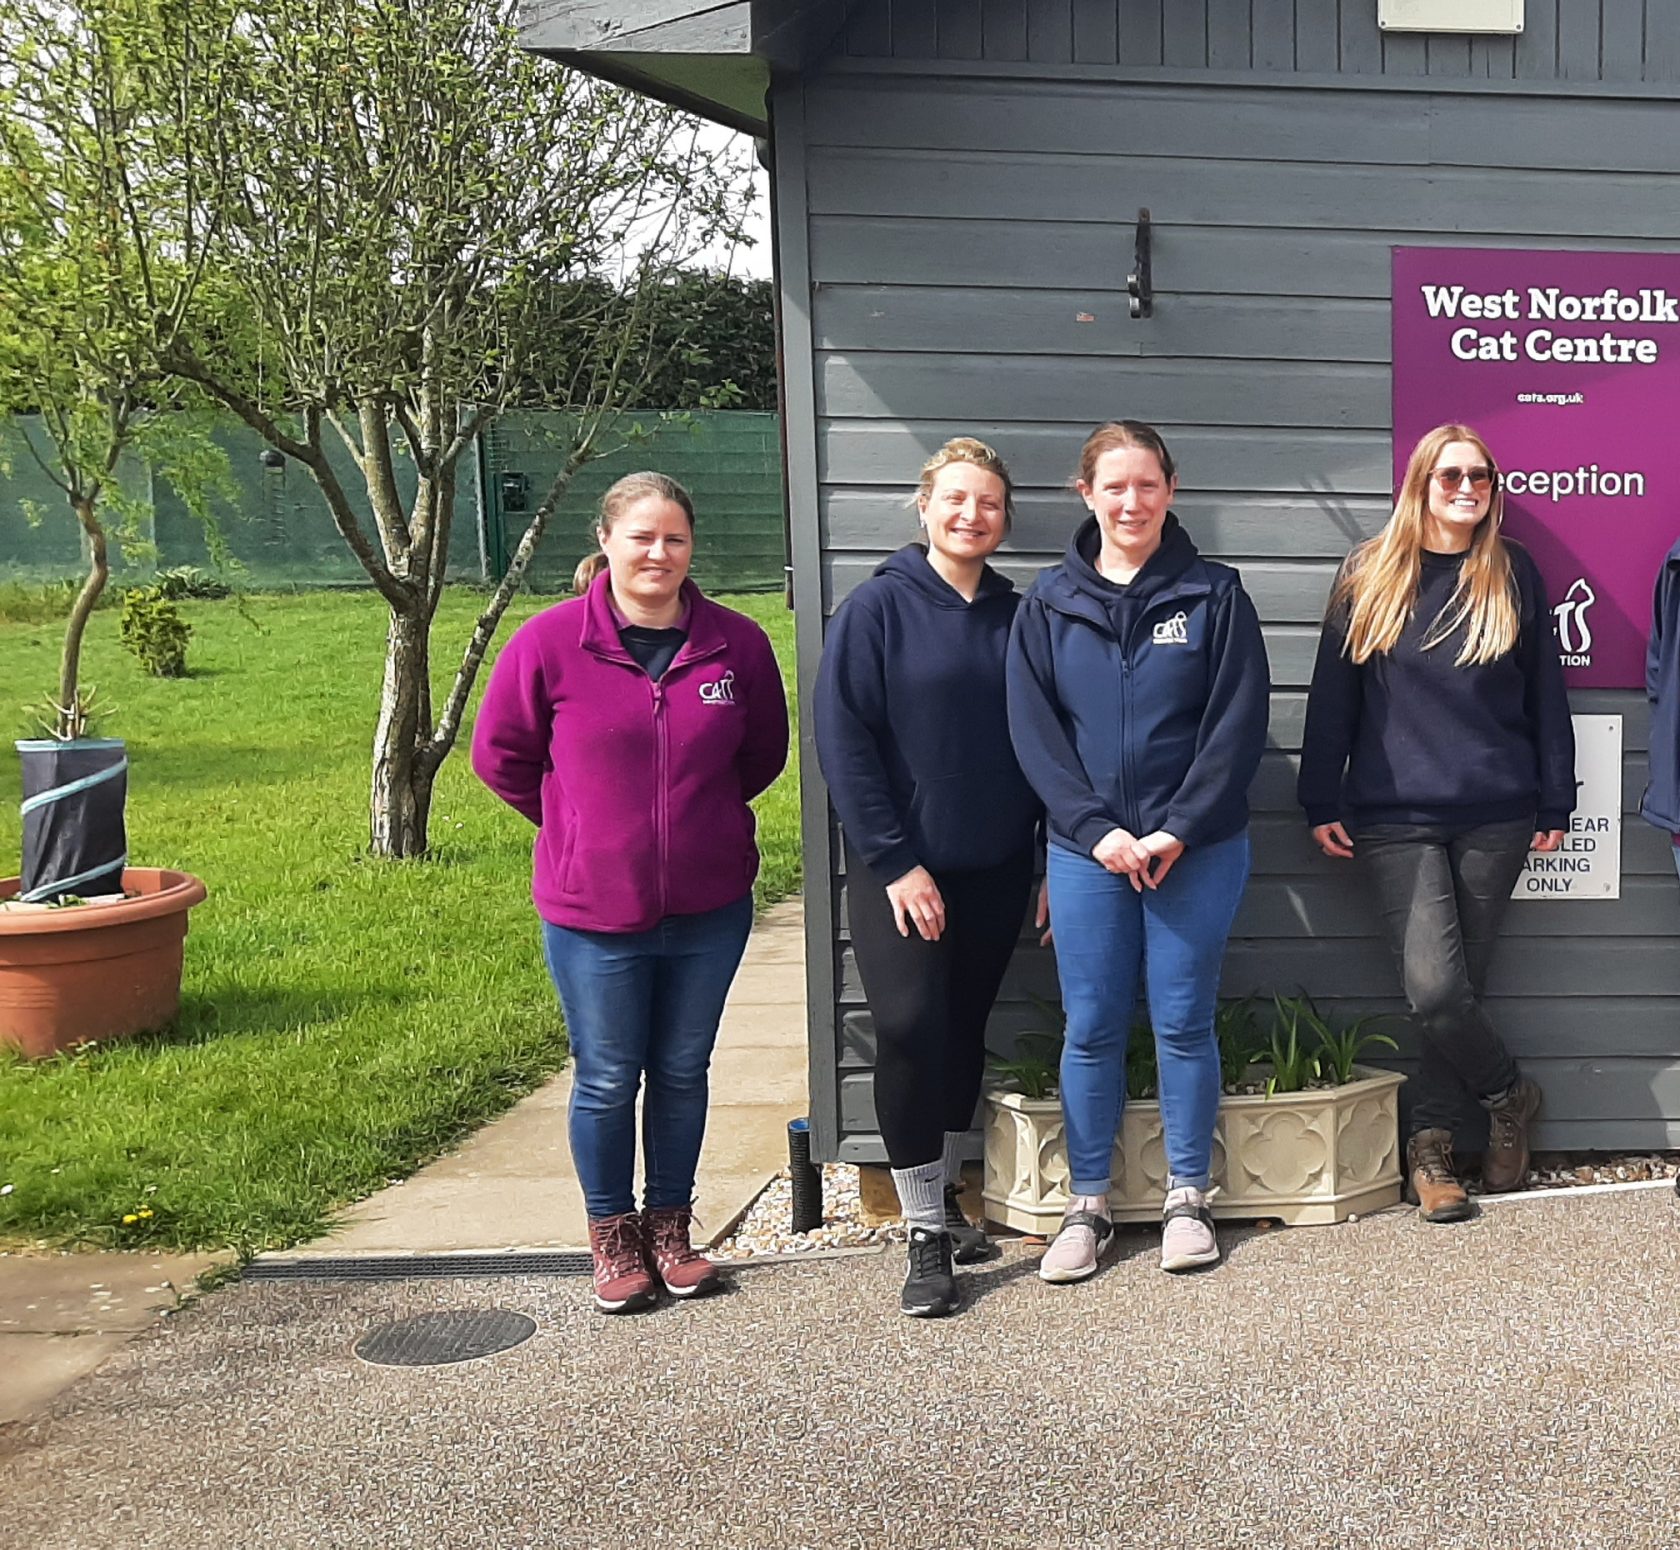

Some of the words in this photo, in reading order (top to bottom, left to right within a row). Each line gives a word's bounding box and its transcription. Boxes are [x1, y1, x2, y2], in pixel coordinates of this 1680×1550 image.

[1421, 285, 1520, 319] West
[1527, 287, 1680, 322] Norfolk
[1451, 327, 1518, 361] Cat
[1524, 328, 1658, 364] Centre
[1517, 392, 1584, 405] cats.org.uk
[1498, 464, 1644, 502] ception
[1551, 578, 1595, 653] TS
[1571, 817, 1609, 832] EAR
[1523, 857, 1591, 873] ARKING
[1526, 877, 1573, 893] ONLY
